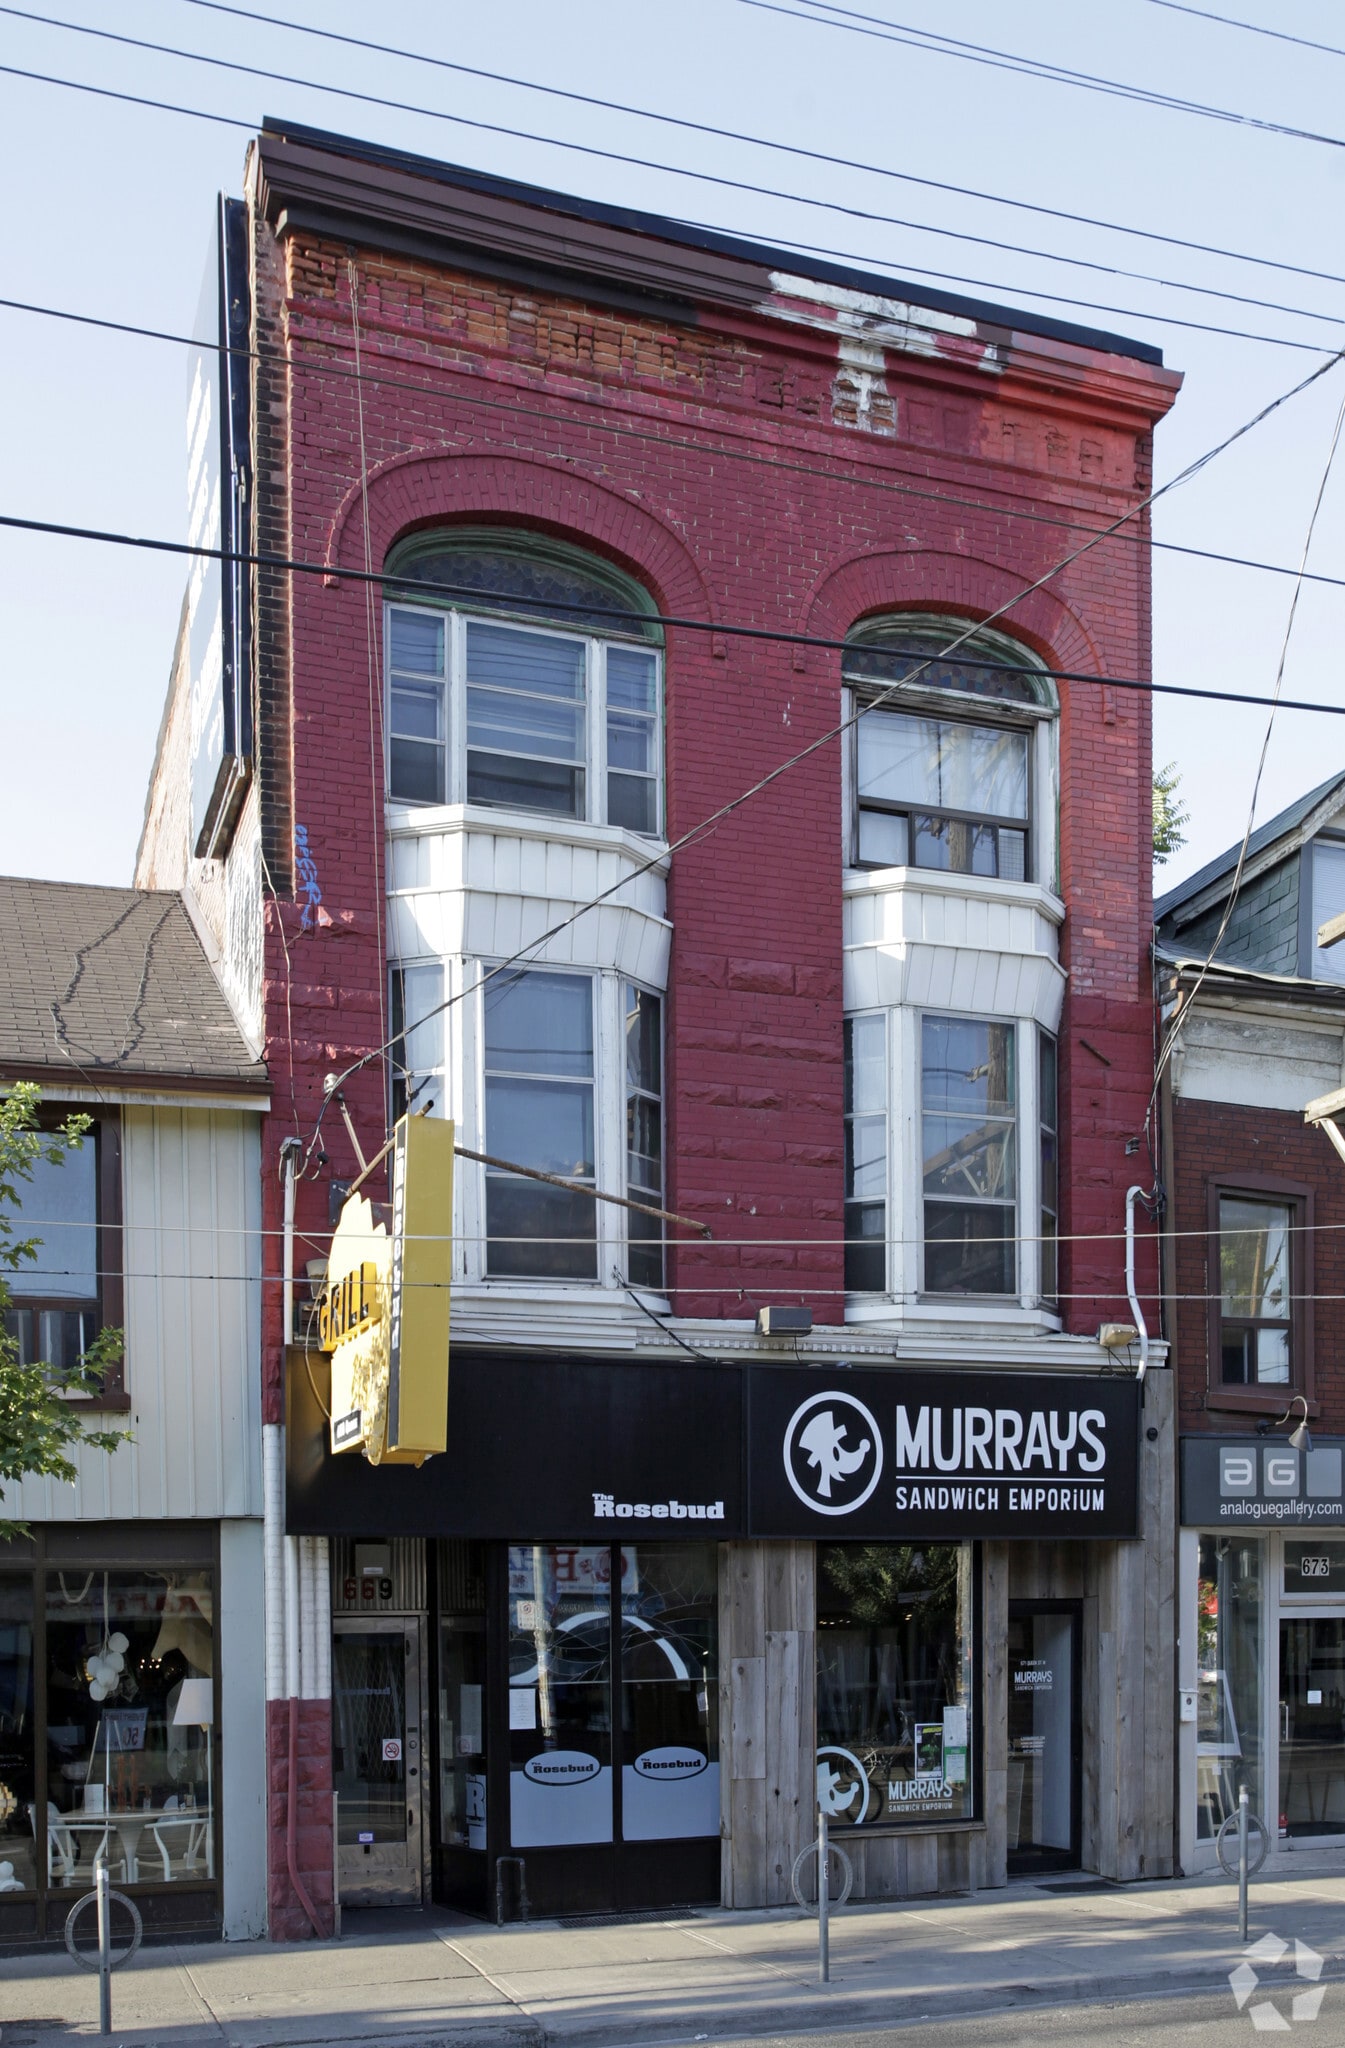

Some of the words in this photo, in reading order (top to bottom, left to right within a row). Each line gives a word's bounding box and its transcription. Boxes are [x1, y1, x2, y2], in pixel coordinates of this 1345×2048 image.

[896, 1405, 1106, 1472] MURRAYS
[594, 1500, 725, 1519] Rosebud
[1220, 1500, 1343, 1519] analoguegallery.com
[1302, 1558, 1329, 1575] 673
[345, 1577, 393, 1600] 669
[1014, 1671, 1052, 1684] MURRAYS
[533, 1764, 594, 1774] Rosebud
[643, 1759, 701, 1770] Rosebud
[888, 1780, 953, 1801] MURRAYS
